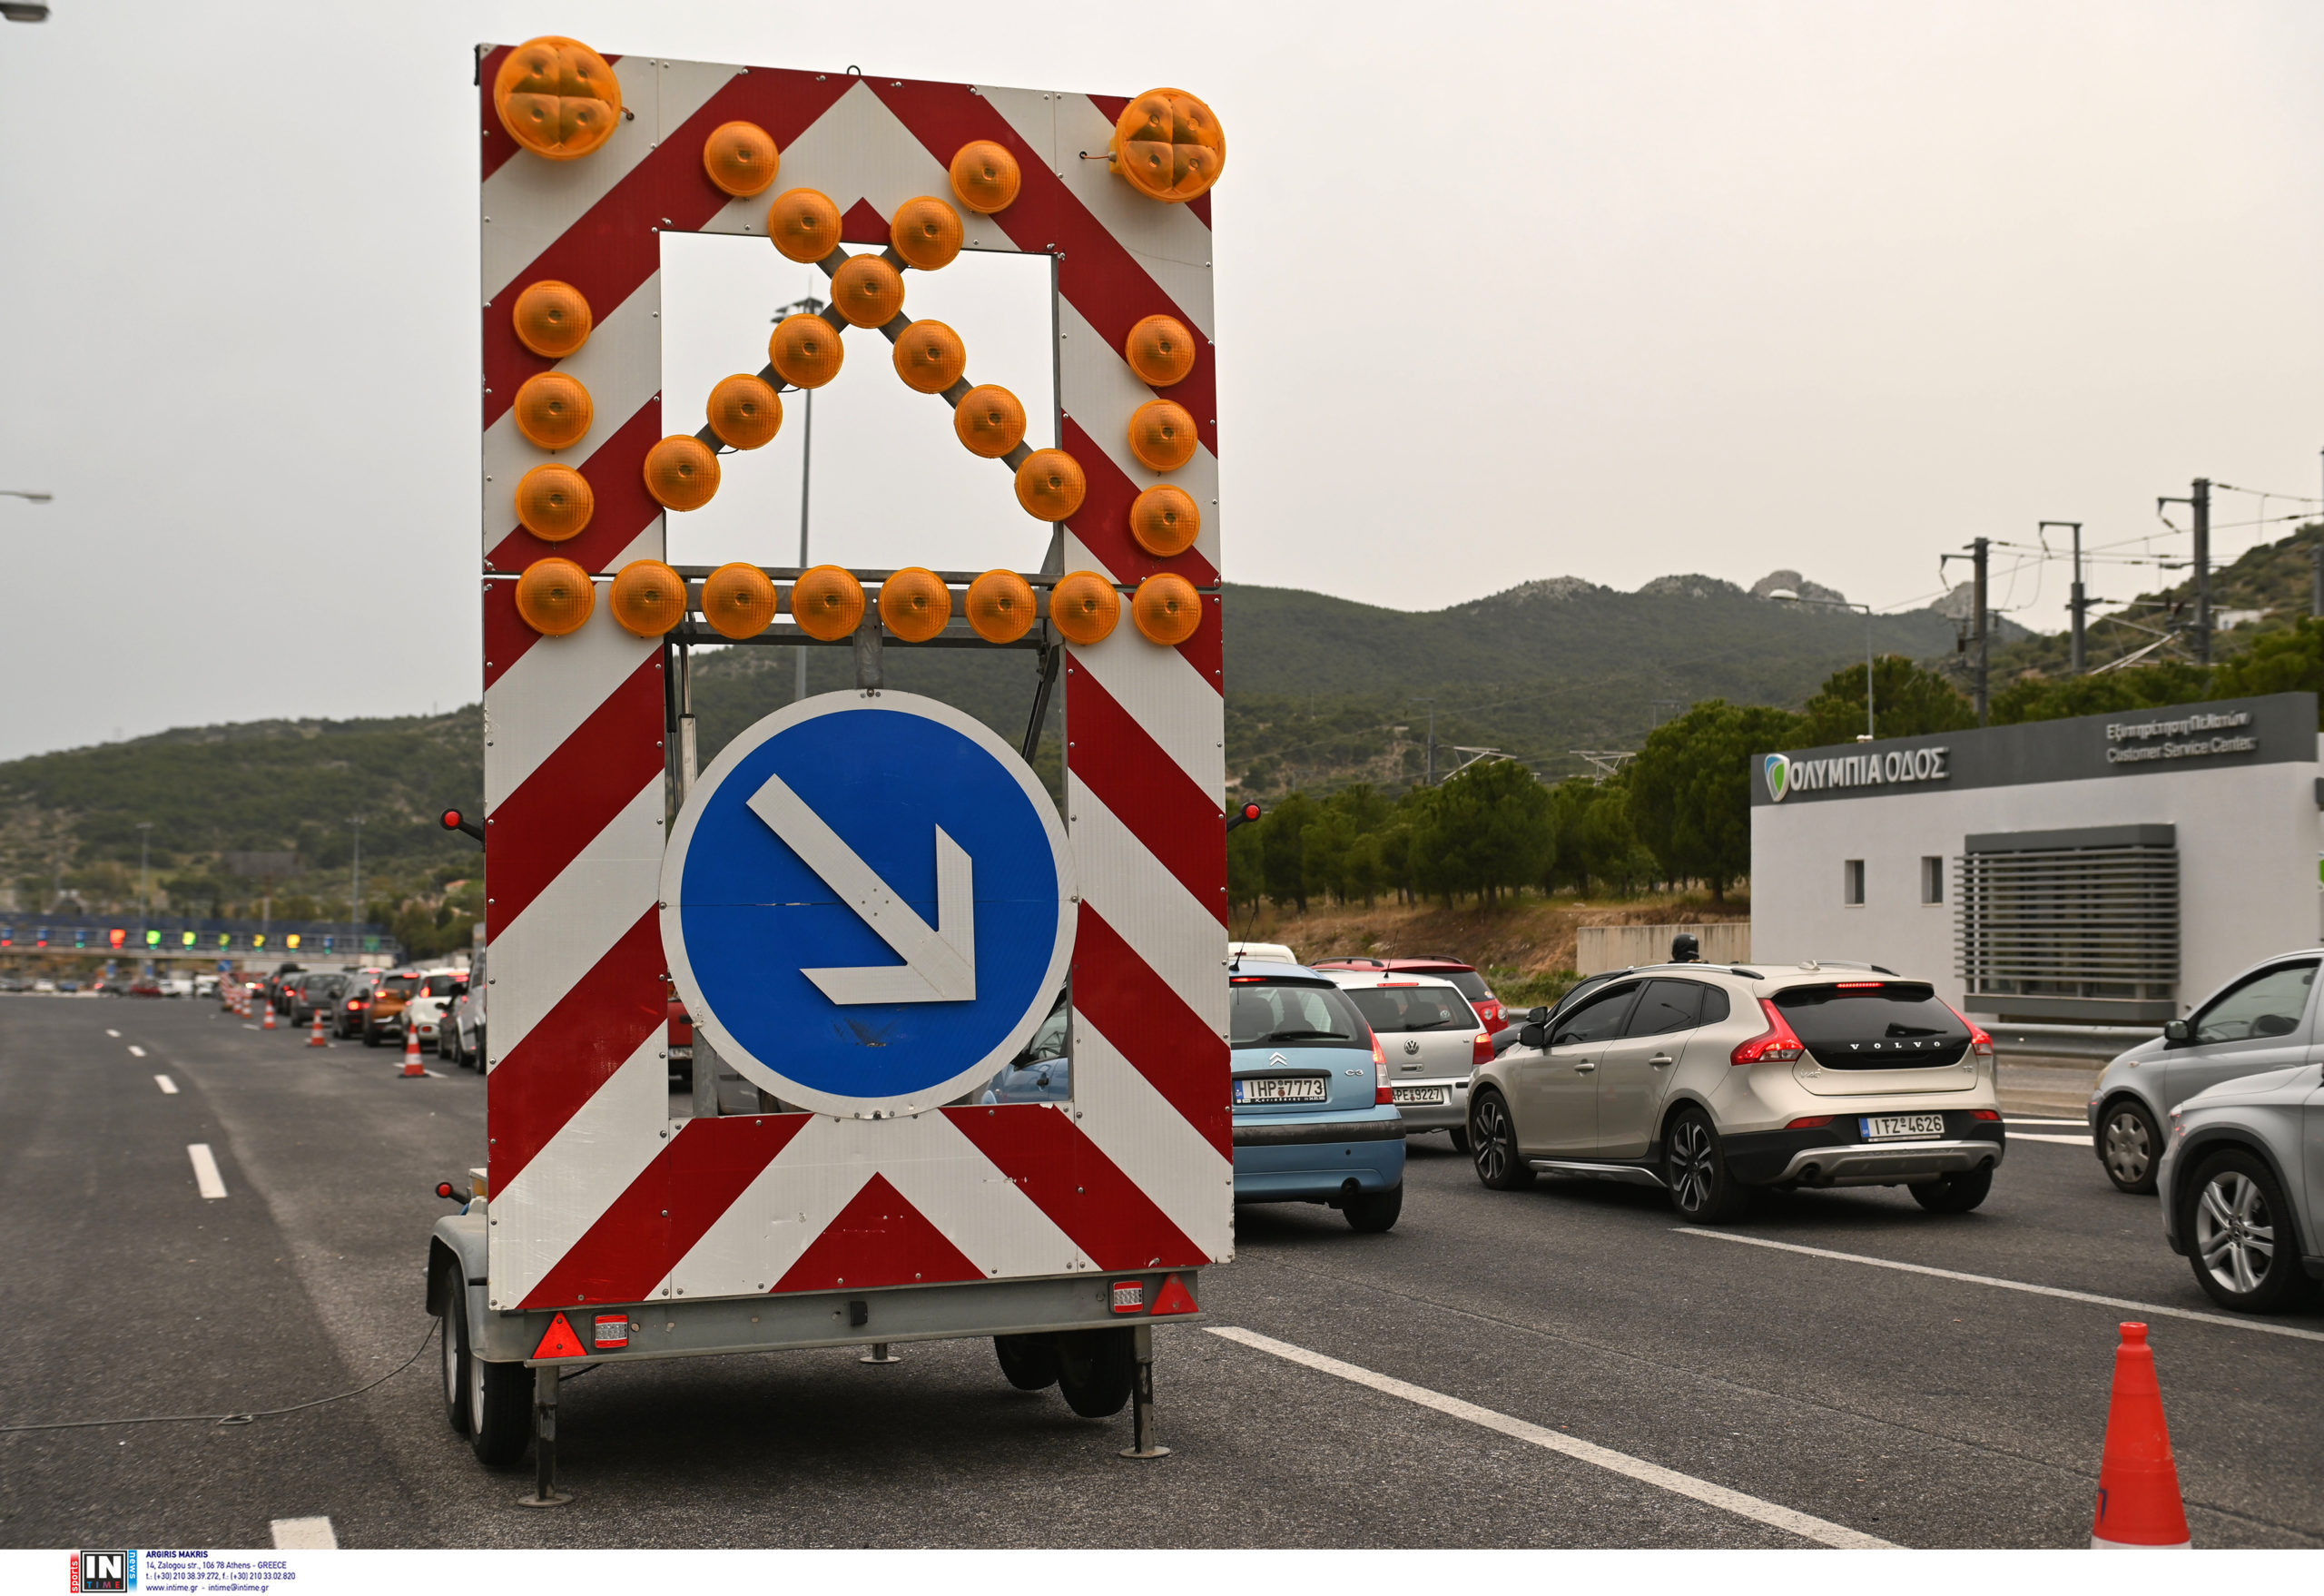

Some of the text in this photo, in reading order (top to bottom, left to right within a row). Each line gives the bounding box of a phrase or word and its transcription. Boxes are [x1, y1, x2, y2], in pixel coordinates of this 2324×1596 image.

[2106, 746, 2162, 763] Customer
[2163, 741, 2209, 758] Service
[1789, 746, 1950, 792] ΟΛΥΜΠΙΑ ΟΔΟΣ
[1850, 1040, 1941, 1050] VOLVO
